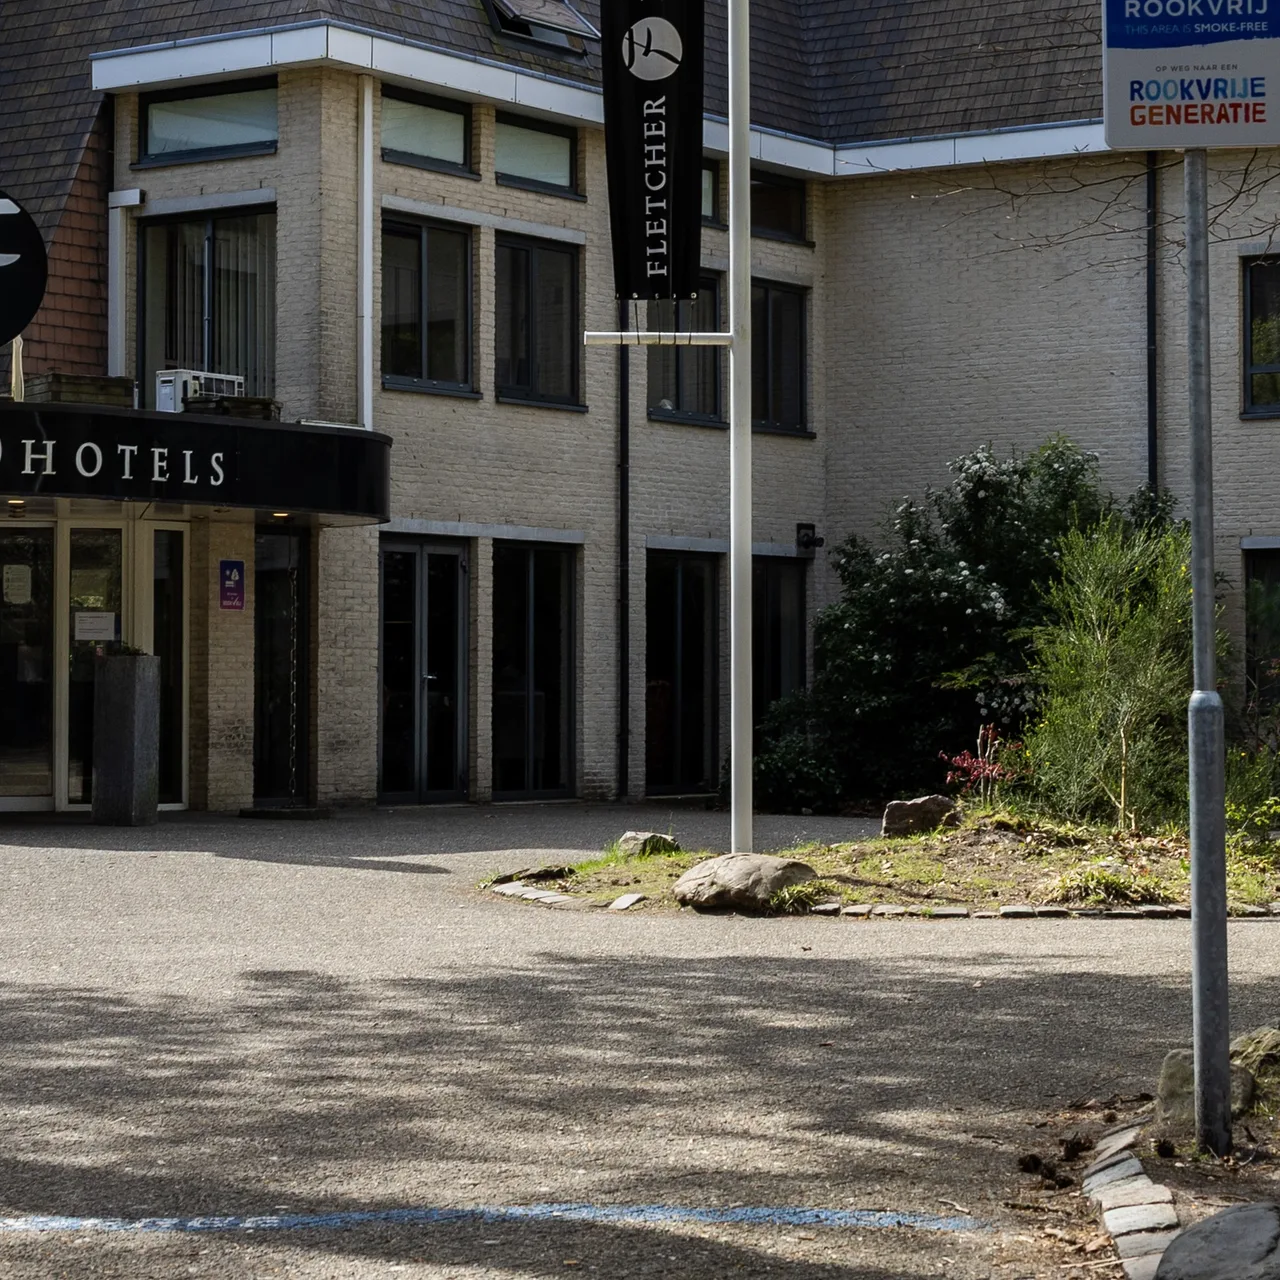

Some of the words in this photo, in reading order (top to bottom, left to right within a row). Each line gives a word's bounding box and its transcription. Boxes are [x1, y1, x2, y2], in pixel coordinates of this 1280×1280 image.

[1125, 24, 1149, 35] THIS
[1150, 24, 1180, 34] AREA
[1183, 23, 1192, 33] IS
[1194, 21, 1269, 33] SMOKE-FREE
[1130, 77, 1266, 101] ROOKVRIJE
[1130, 102, 1267, 126] GENERATIE
[643, 95, 668, 278] FLETCHER
[21, 439, 225, 486] HOTELS
